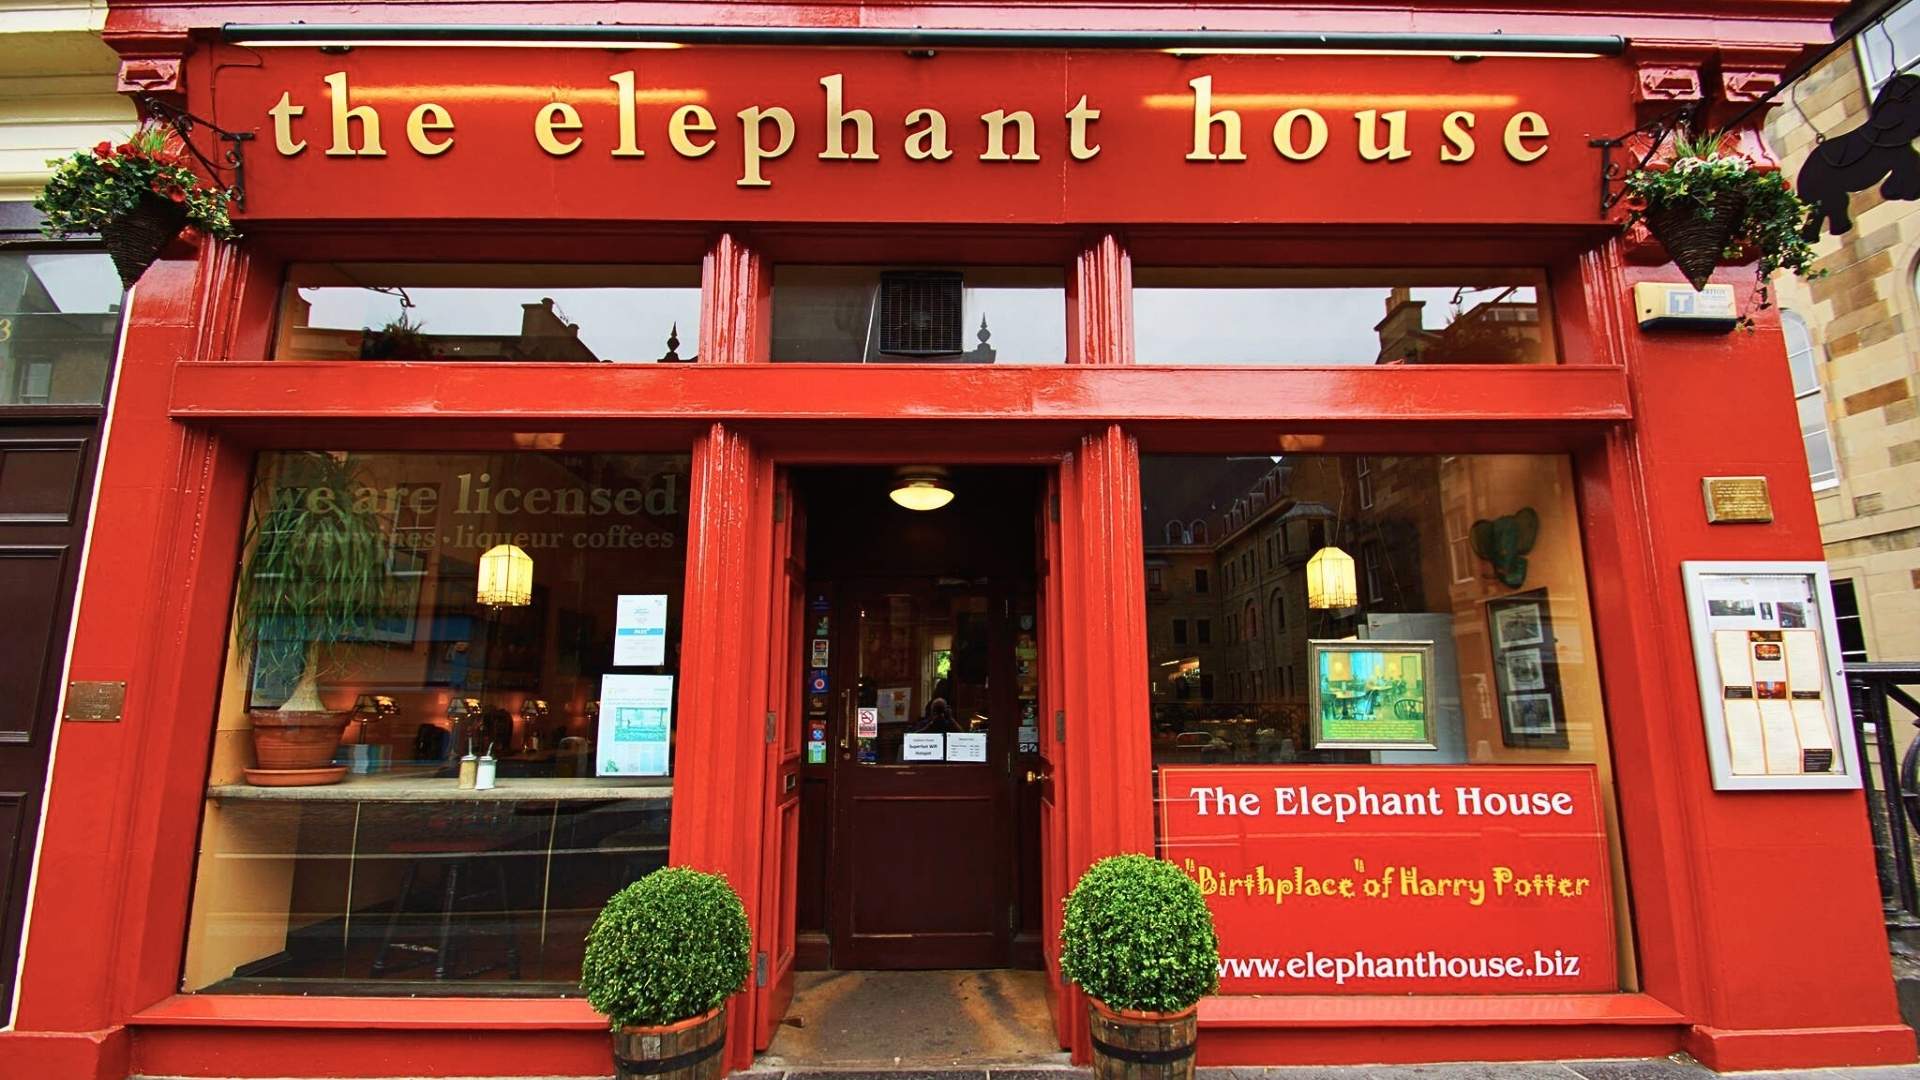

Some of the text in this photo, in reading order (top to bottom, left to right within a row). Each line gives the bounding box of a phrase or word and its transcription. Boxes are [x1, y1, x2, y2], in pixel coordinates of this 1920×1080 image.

[268, 70, 1550, 187] the elephant house
[277, 472, 678, 516] we are licensed
[572, 524, 675, 549] coffees
[1189, 786, 1574, 823] The Elephant House
[1363, 866, 1396, 898] of
[1399, 866, 1486, 906] Harry
[1492, 866, 1590, 898] Potter
